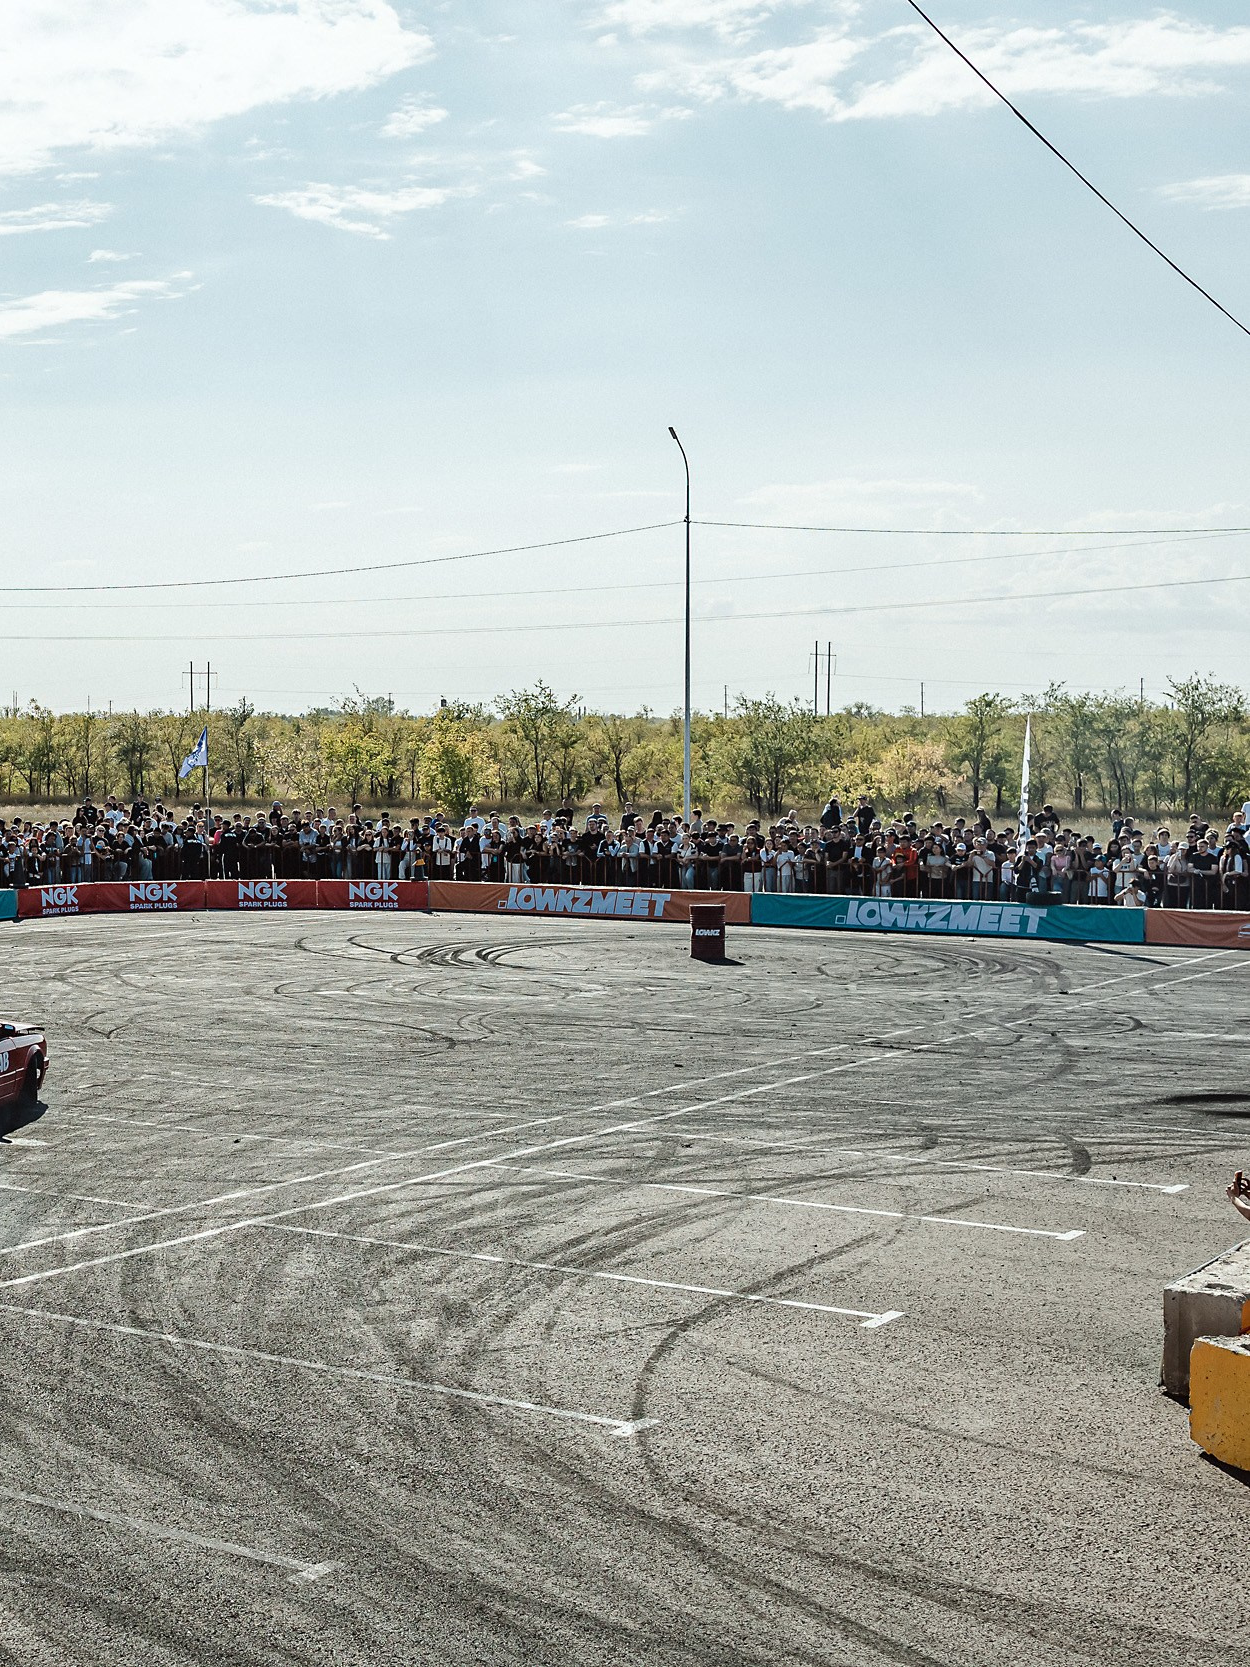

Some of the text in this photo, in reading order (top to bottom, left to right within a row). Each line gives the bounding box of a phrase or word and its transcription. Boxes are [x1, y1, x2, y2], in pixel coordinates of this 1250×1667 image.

[41, 886, 79, 906] NGK
[129, 883, 178, 902] NGK
[238, 882, 288, 900] NGK
[349, 882, 399, 900] NGK
